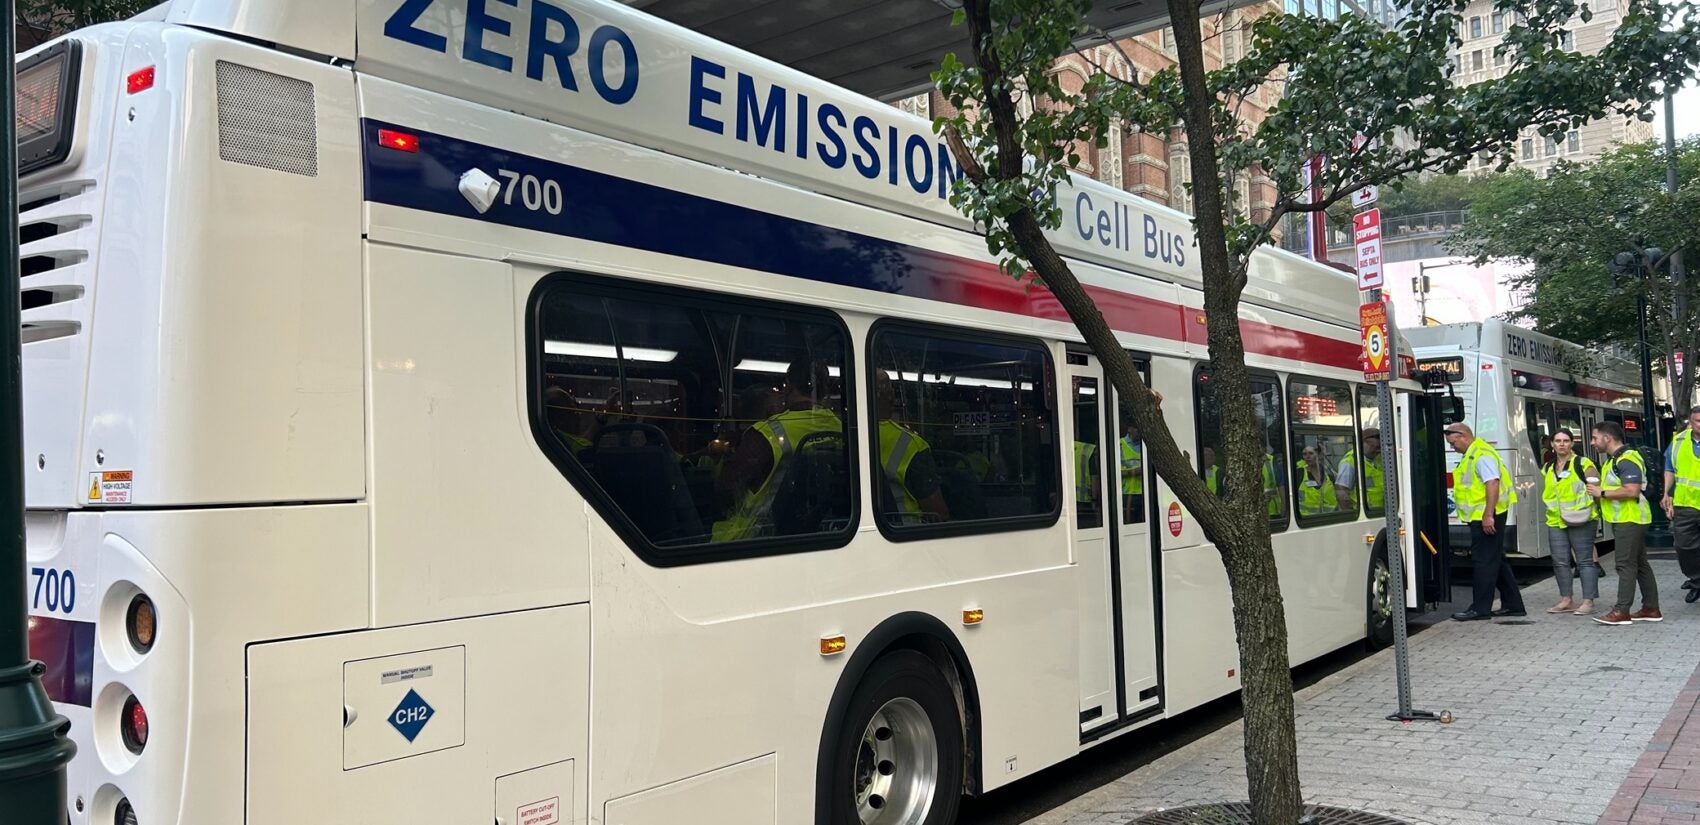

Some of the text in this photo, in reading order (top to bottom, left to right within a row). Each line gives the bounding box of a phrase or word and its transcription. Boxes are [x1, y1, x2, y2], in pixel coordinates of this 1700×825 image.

[384, 0, 639, 104] ZERO
[498, 168, 563, 215] 700
[1076, 192, 1129, 251] Cell
[1143, 213, 1185, 267] Bus
[1356, 225, 1379, 240] STOPPING
[1362, 245, 1376, 256] SEPTA
[1360, 256, 1380, 269] BUS ONLY
[1371, 334, 1380, 353] 5
[1507, 334, 1527, 358] ZERO
[32, 568, 75, 613] 700
[395, 706, 427, 725] CH2
